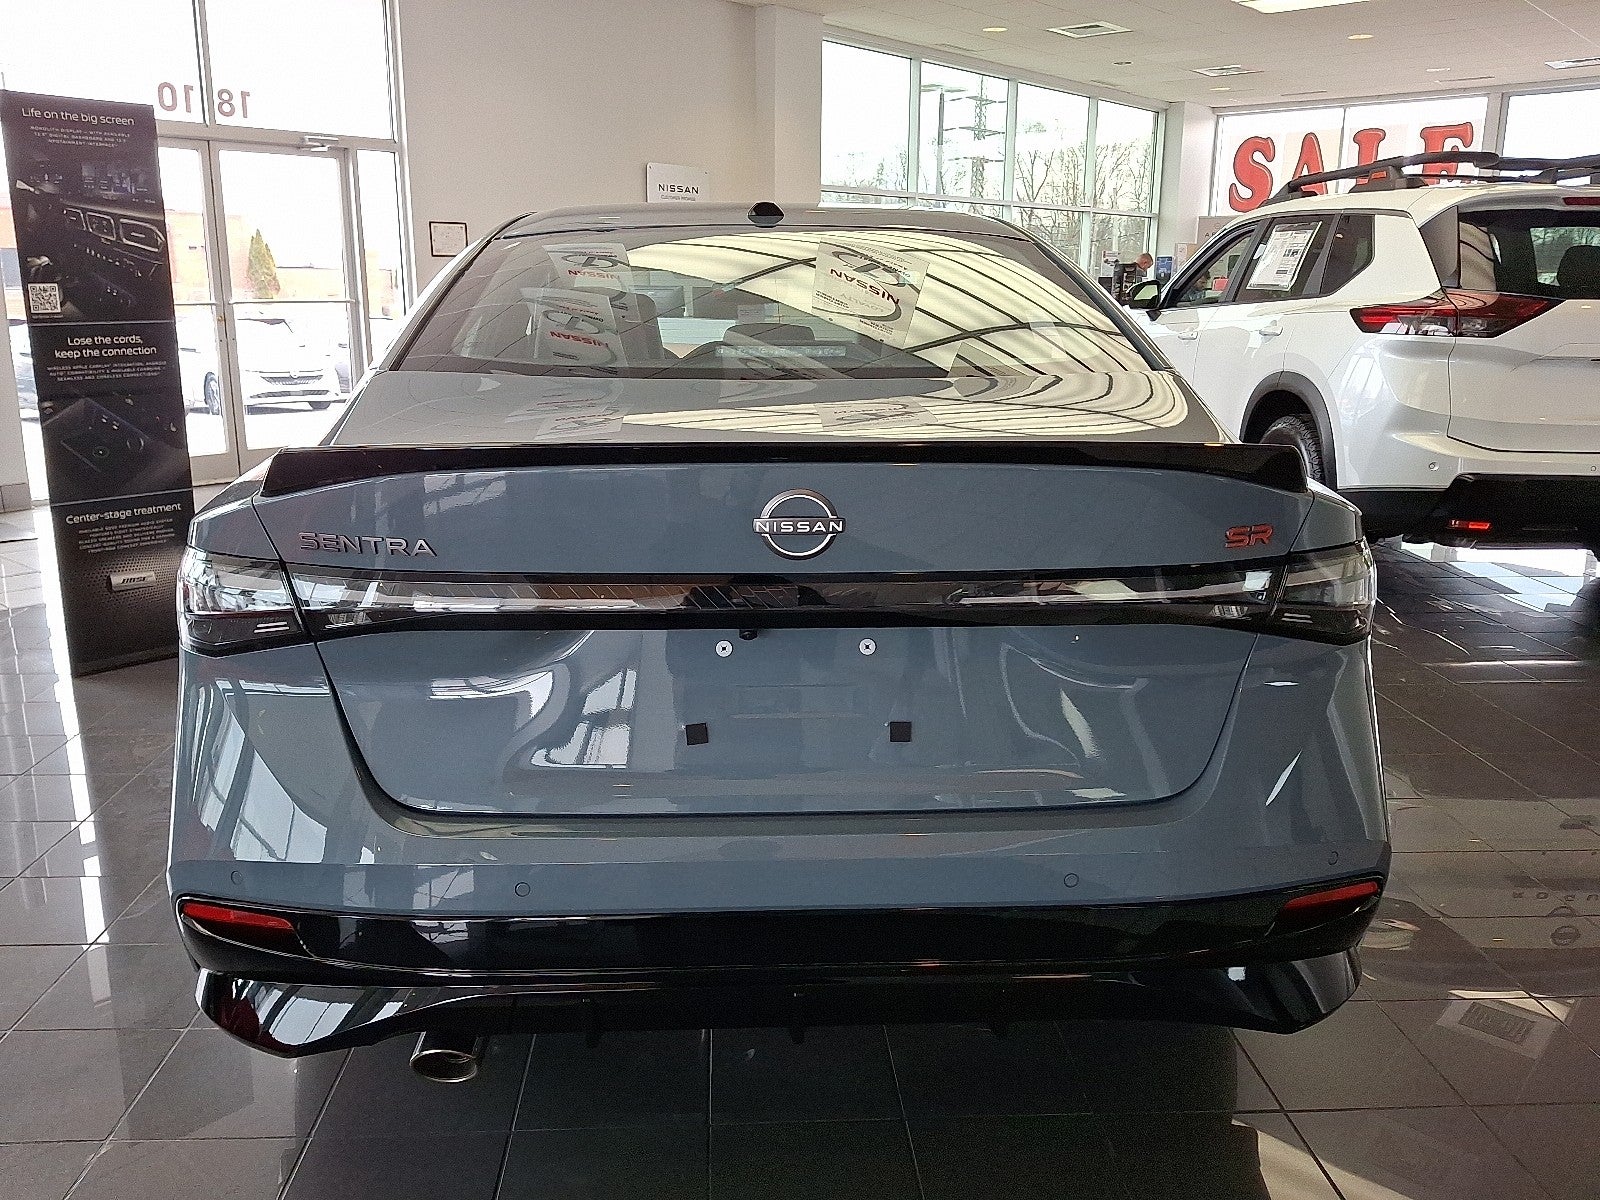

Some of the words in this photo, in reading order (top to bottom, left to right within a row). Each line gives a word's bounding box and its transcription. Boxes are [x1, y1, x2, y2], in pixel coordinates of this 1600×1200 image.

[21, 108, 41, 118] Life
[44, 111, 58, 120] on
[61, 111, 79, 121] the
[81, 113, 97, 125] big
[100, 115, 135, 126] screen
[1229, 122, 1474, 213] SALE
[658, 183, 699, 195] NISSAN
[830, 268, 900, 305] NISSAN
[67, 336, 93, 346] Lose
[94, 335, 112, 345] the
[113, 334, 143, 345] cords,
[54, 349, 80, 359] keep
[82, 348, 100, 358] the
[101, 346, 157, 357] connection
[65, 509, 132, 525] Center-stage
[133, 503, 181, 516] treatment
[754, 519, 844, 533] NISSAN
[1225, 523, 1274, 548] SR
[298, 531, 438, 557] SENTRA
